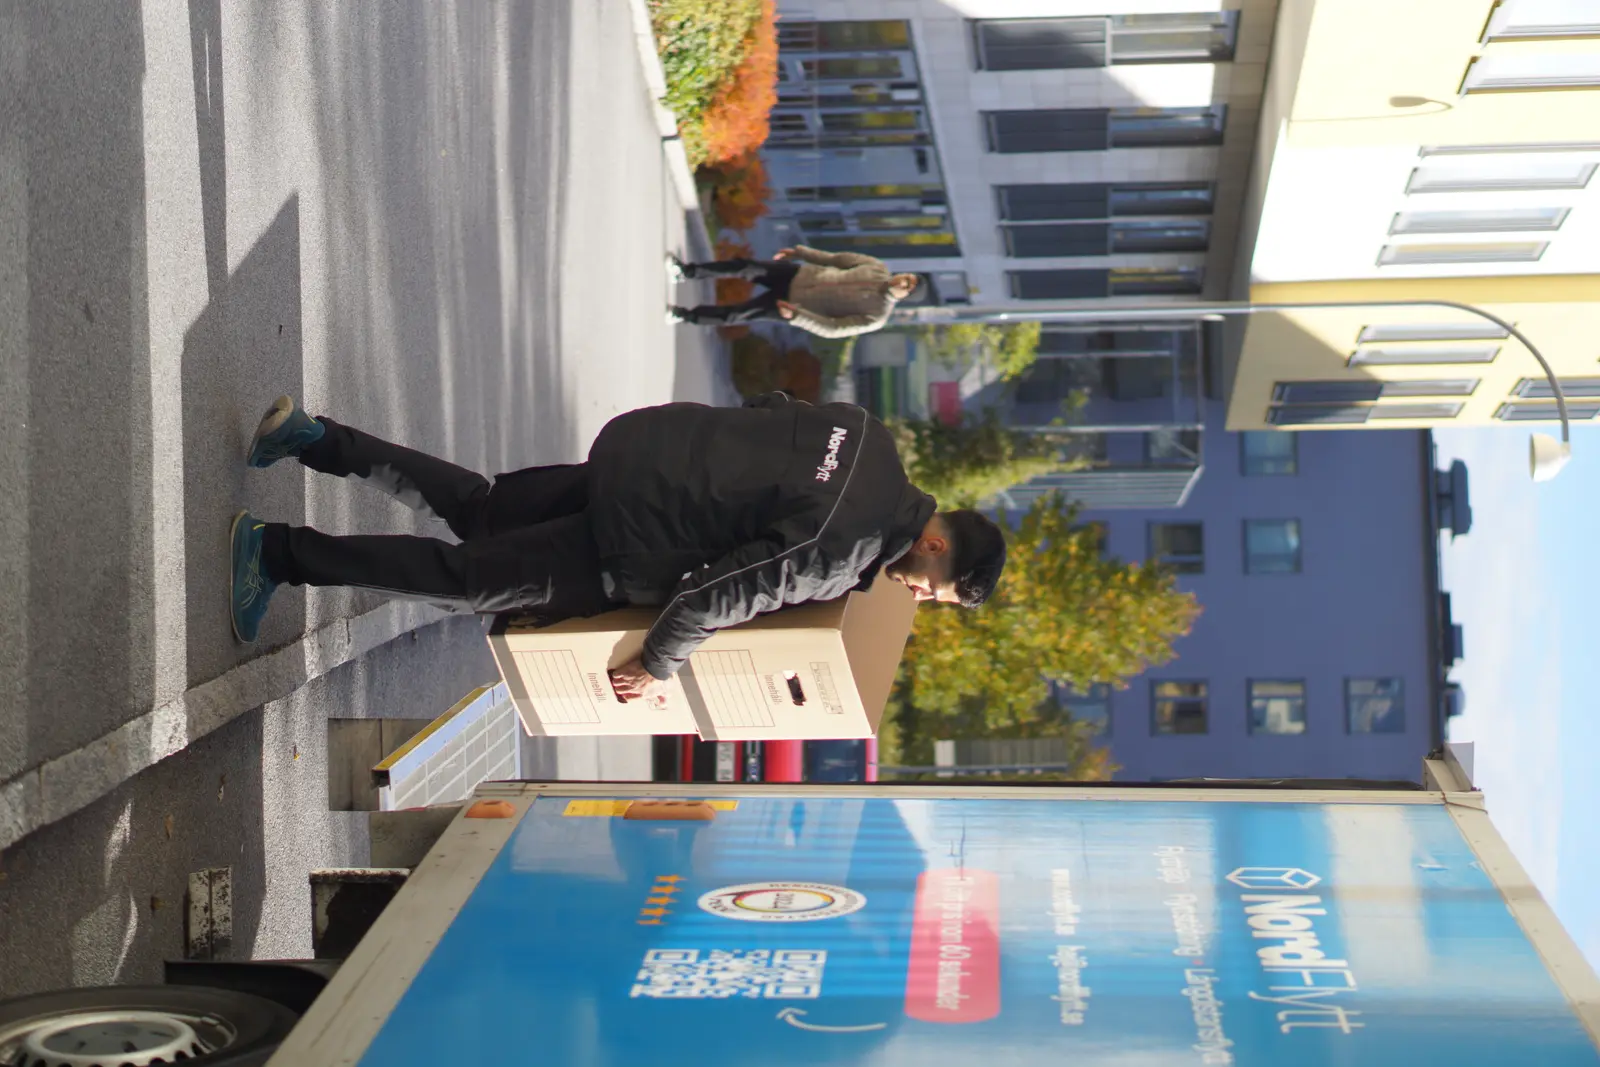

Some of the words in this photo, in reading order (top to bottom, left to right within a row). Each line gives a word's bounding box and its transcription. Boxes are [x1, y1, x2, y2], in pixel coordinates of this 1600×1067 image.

[940, 920, 972, 943] inom
[938, 945, 972, 960] 60
[1240, 894, 1365, 1034] NordFlytt
[935, 961, 972, 1011] sekunder
